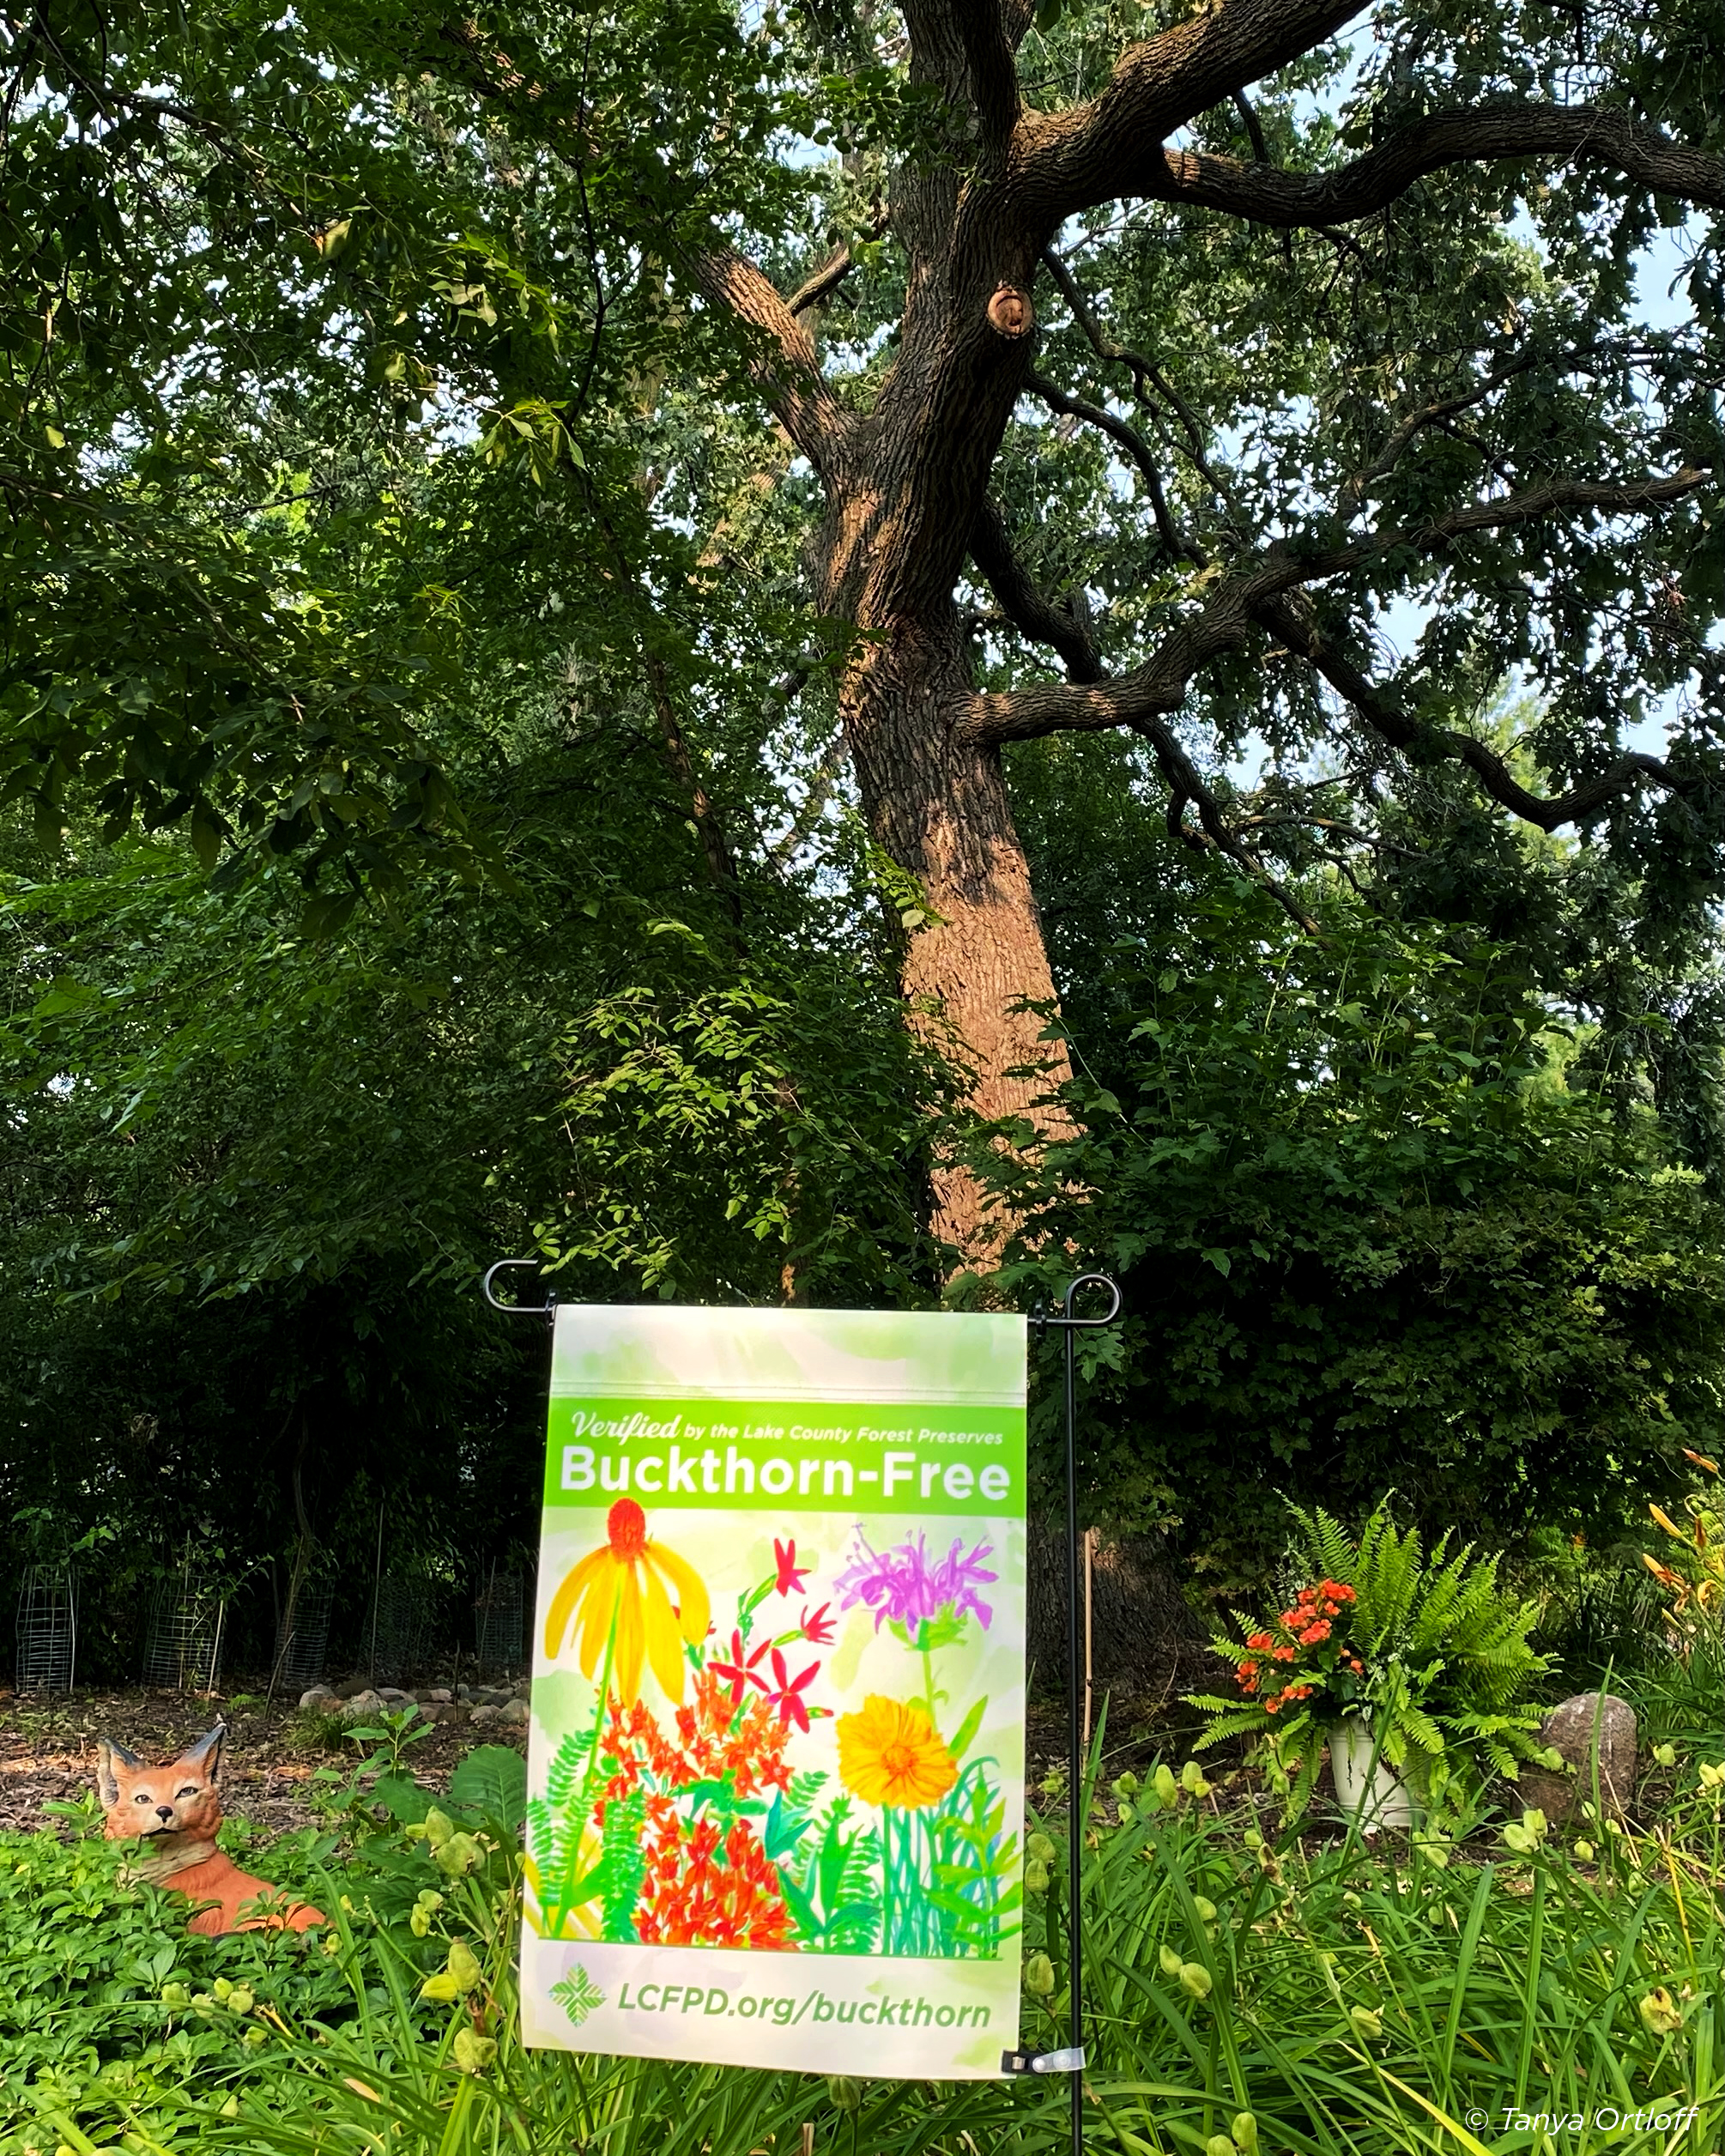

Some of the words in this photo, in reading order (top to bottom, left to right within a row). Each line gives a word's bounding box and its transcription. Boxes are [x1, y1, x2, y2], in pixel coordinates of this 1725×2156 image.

[571, 1411, 684, 1446] Verified
[684, 1423, 705, 1442] by
[711, 1423, 739, 1439] the
[743, 1424, 784, 1440] Lake
[790, 1426, 852, 1444] County
[856, 1426, 913, 1444] Forest
[917, 1428, 1003, 1445] Preserves
[560, 1445, 1011, 1500] Buckthorn-Free
[617, 1982, 991, 2028] LCFPD.org/buckthorn
